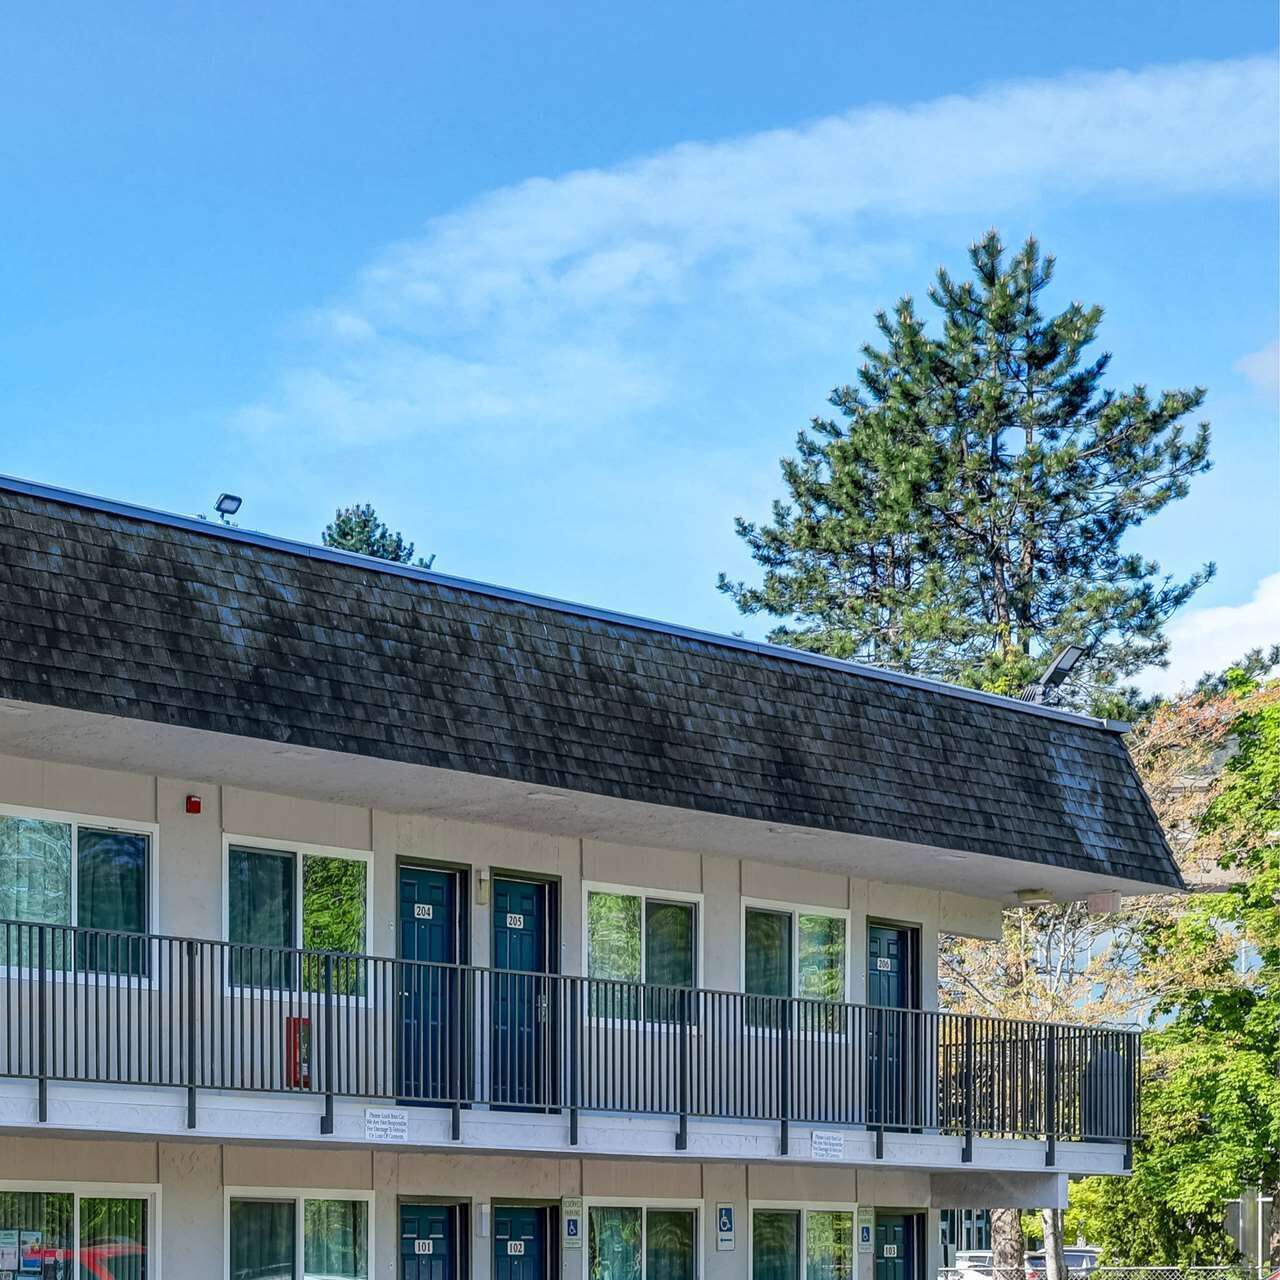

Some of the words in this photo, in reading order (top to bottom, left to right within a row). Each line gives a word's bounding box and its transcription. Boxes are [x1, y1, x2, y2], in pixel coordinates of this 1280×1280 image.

[416, 905, 431, 917] 204
[508, 915, 522, 927] 205
[417, 1242, 431, 1253] 101
[509, 1242, 522, 1254] 102
[885, 1246, 896, 1256] 103
